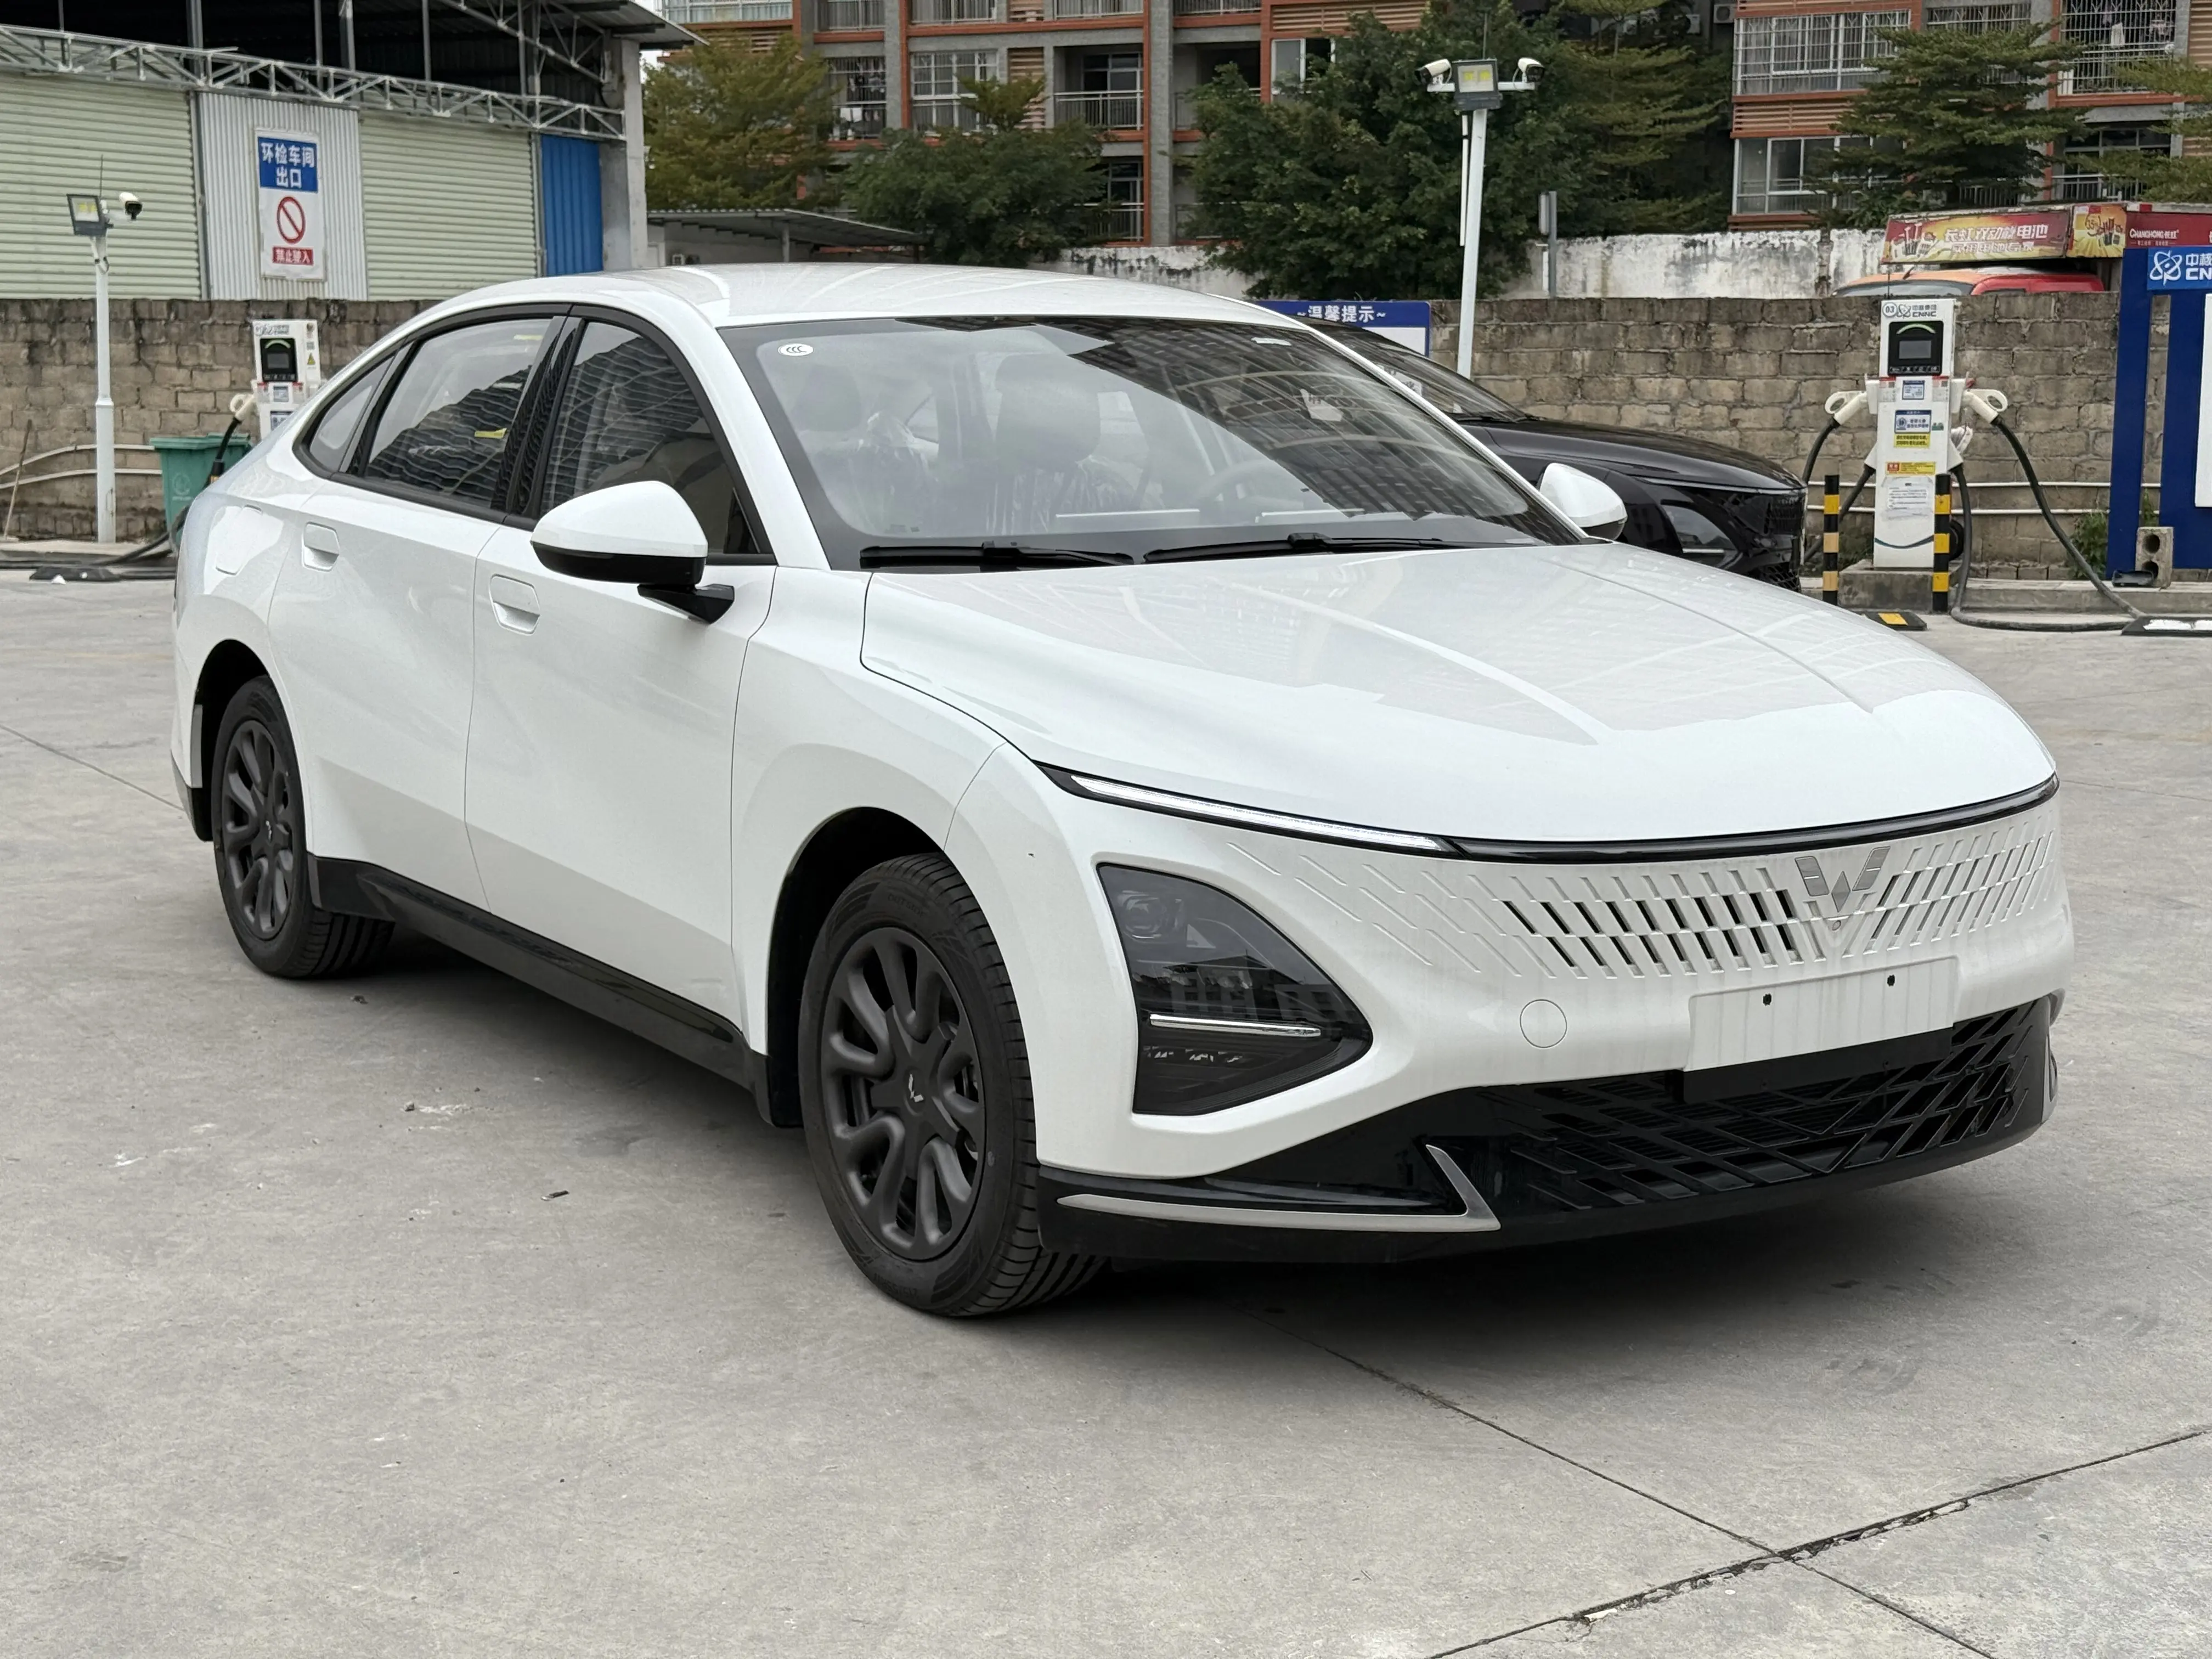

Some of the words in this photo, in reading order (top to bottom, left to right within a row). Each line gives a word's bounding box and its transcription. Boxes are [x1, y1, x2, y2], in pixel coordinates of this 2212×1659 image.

[261, 142, 315, 168] 环检车间
[276, 166, 302, 188] 出口
[2129, 228, 2164, 239] CHANGHONG
[1885, 306, 1895, 314] 03
